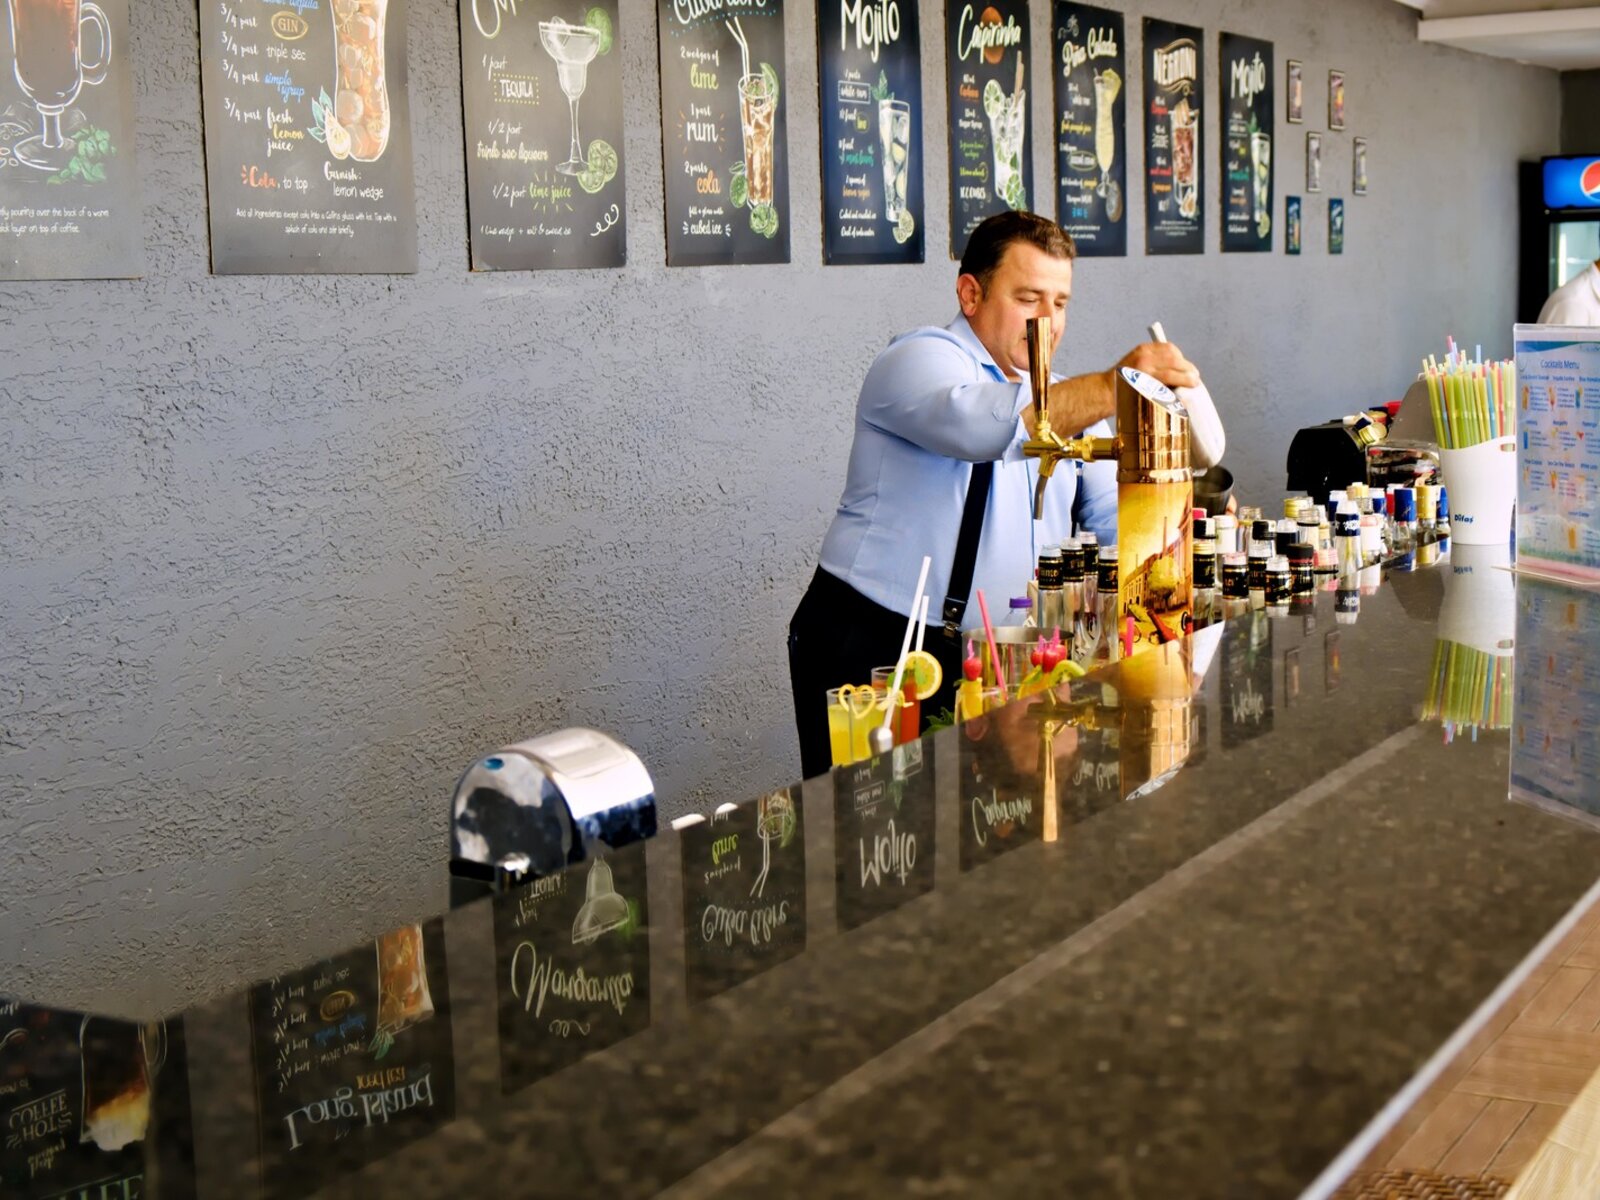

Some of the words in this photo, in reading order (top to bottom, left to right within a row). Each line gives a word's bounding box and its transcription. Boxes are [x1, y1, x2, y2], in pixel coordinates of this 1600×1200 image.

[277, 17, 299, 33] GIN
[841, 0, 900, 63] Mojito
[958, 4, 1021, 64] Caipirinha
[266, 42, 288, 63] triple
[291, 48, 307, 61] sec
[691, 63, 719, 90] lime
[1231, 52, 1266, 107] Mojito
[500, 79, 534, 98] TEQUILA
[266, 106, 294, 129] fresh
[273, 123, 305, 140] lemon
[686, 121, 719, 142] rum
[267, 138, 294, 157] juice
[283, 176, 292, 189] to
[294, 177, 309, 195] top
[333, 182, 358, 199] lemon
[359, 187, 384, 201] wedge
[528, 182, 548, 198] lime
[697, 169, 720, 194] cola
